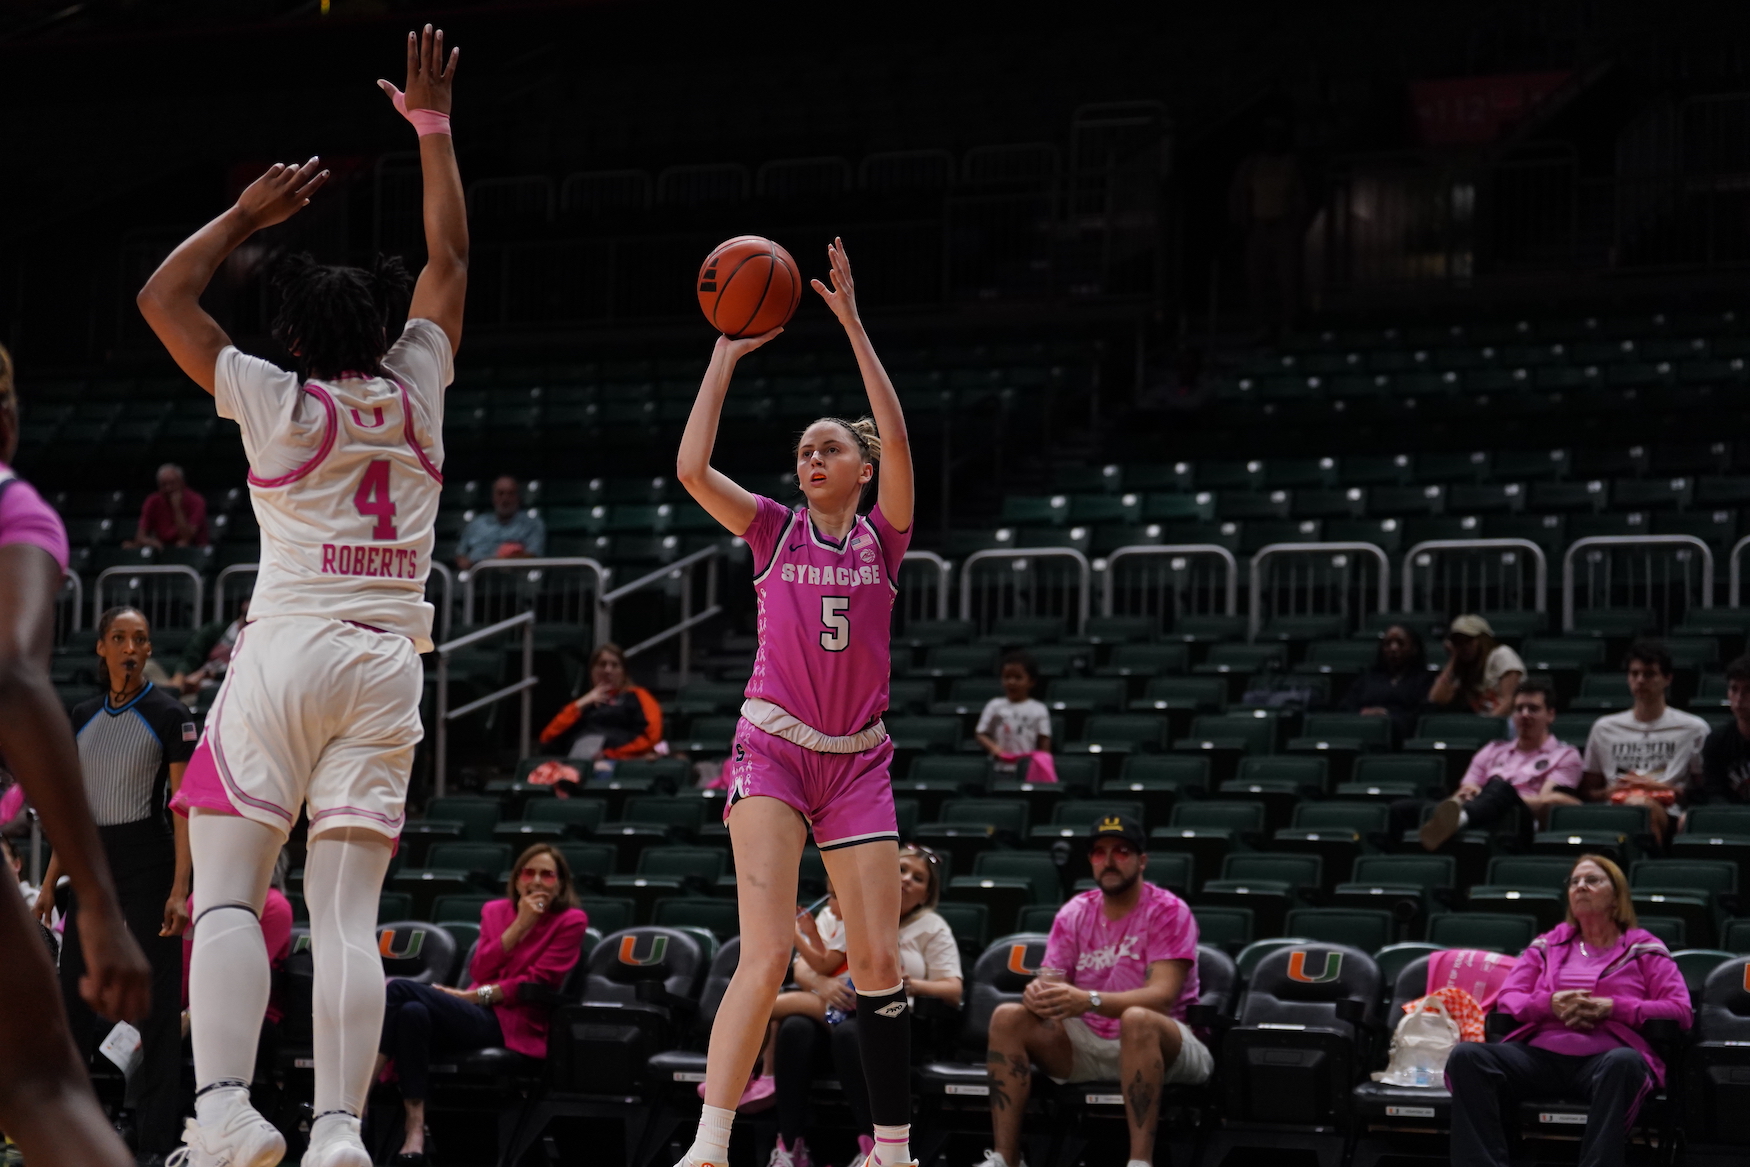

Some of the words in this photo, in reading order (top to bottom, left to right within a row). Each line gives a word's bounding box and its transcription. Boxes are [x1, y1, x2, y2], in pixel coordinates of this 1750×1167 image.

[350, 407, 385, 428] U
[353, 459, 398, 541] 4
[321, 543, 417, 579] ROBERTS
[820, 595, 850, 652] 5
[379, 929, 427, 960] U
[618, 935, 669, 967] U
[1286, 951, 1344, 983] U
